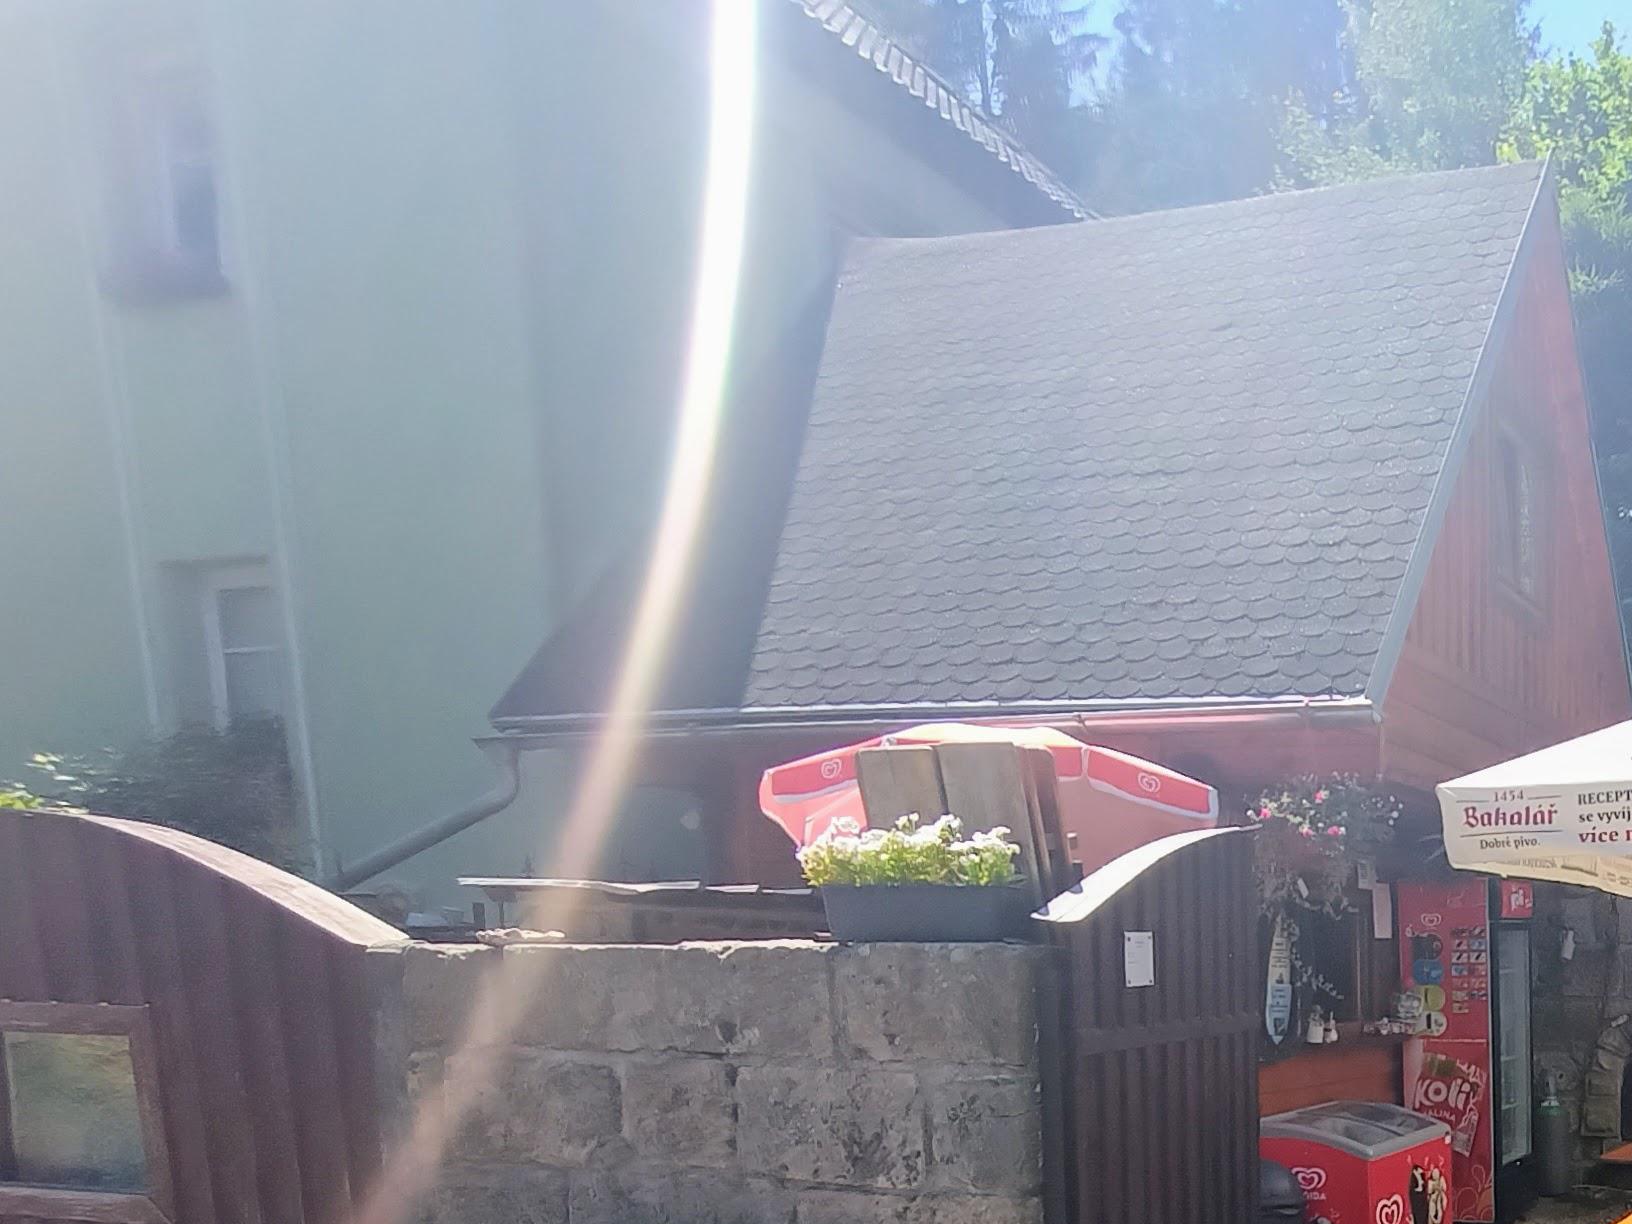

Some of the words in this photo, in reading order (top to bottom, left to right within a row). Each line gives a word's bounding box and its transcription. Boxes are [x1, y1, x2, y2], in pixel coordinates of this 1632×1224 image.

[1494, 790, 1524, 802] 1454
[1463, 803, 1558, 828] Bakalář
[1578, 812, 1594, 823] se
[1578, 826, 1619, 843] více
[1480, 835, 1512, 850] Dobré
[1514, 837, 1541, 851] pivo.
